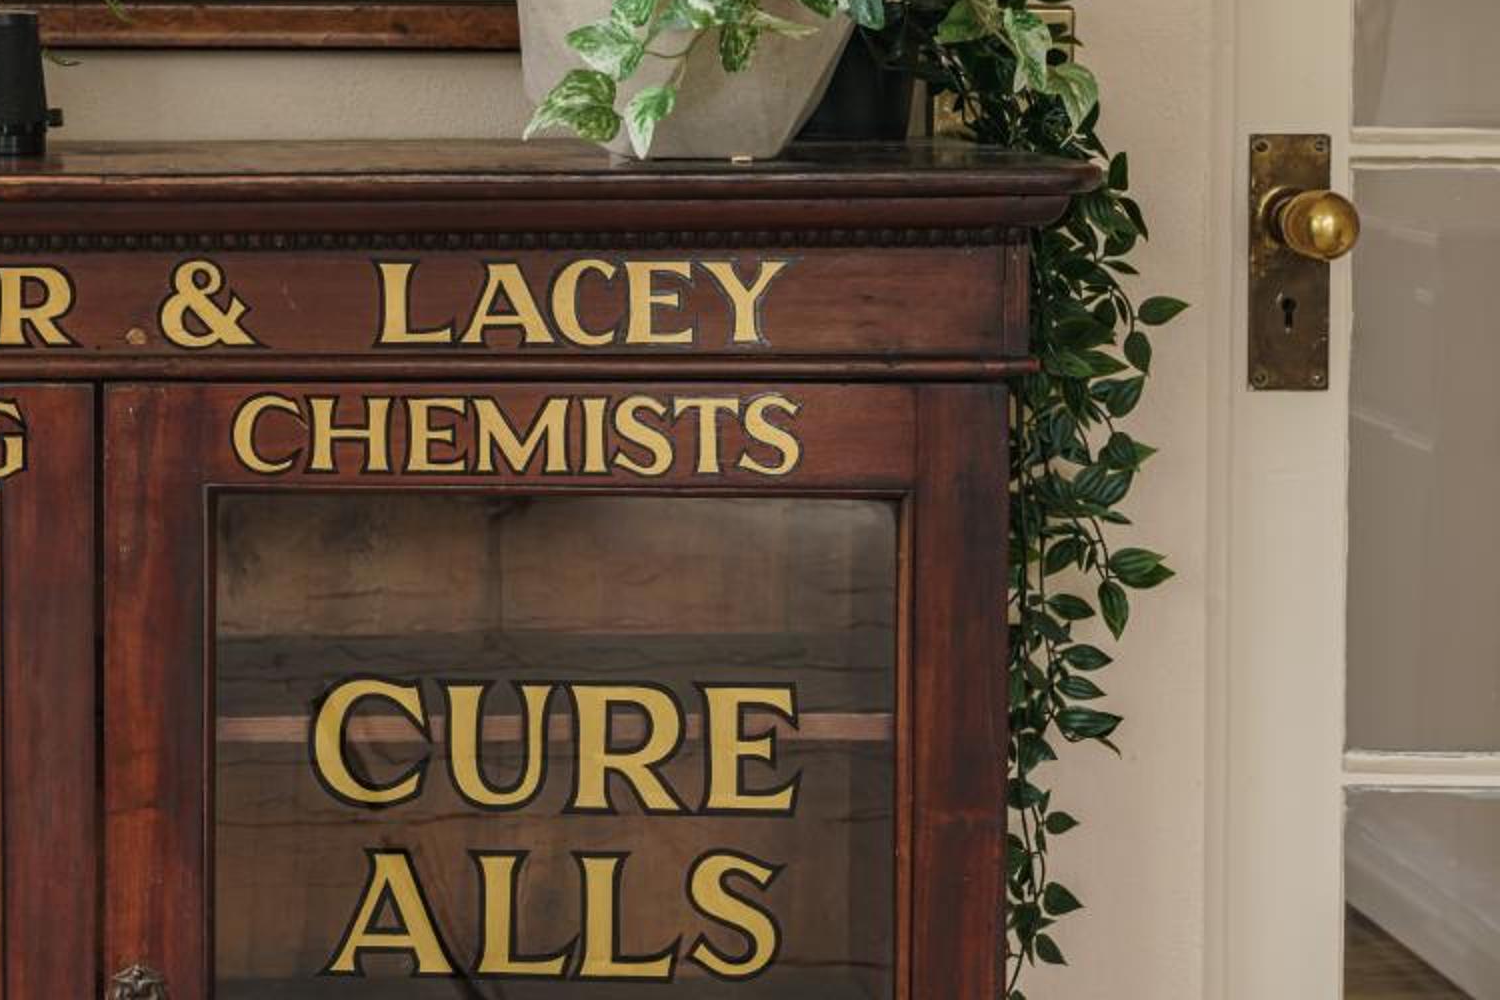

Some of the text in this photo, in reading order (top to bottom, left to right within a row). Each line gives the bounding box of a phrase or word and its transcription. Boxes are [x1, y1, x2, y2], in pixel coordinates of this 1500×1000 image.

[159, 258, 258, 349] &
[376, 258, 787, 348] LACEY
[231, 392, 803, 477] CHEMISTS
[312, 677, 797, 813] CURE
[327, 852, 780, 981] ALLS
